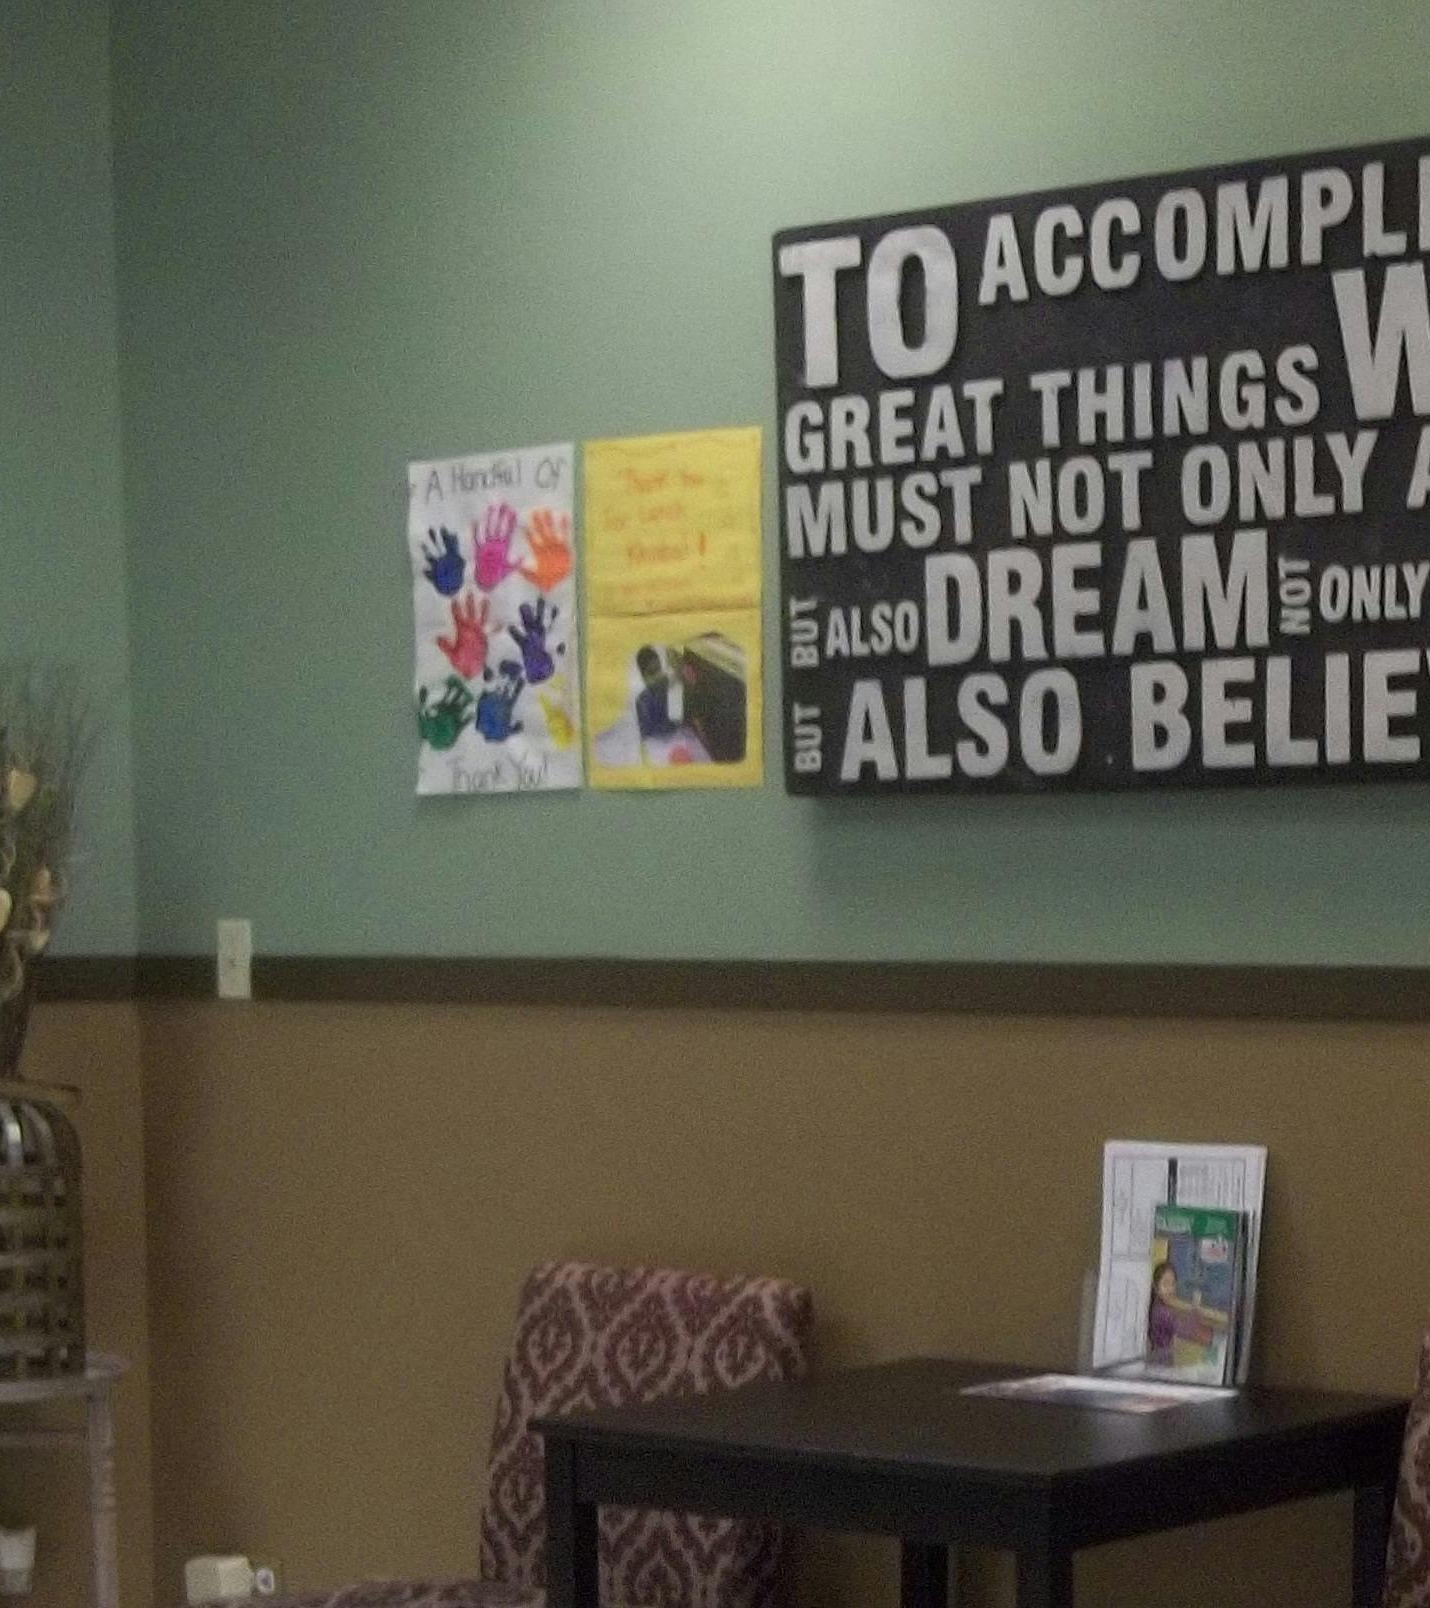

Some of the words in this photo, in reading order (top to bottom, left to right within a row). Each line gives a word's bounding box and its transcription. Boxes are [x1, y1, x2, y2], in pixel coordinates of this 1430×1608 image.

[778, 224, 959, 389] TO
[785, 377, 1007, 475] GREAT
[1030, 344, 1321, 449] THINGS
[424, 469, 444, 506] A
[785, 467, 982, 559] MUST
[1009, 451, 1155, 539] NOT
[1181, 428, 1376, 526] ONLY
[790, 595, 821, 669] BUT
[825, 599, 921, 658] ALSO
[925, 530, 1271, 669] DREAM
[1278, 556, 1313, 636] NOT
[1318, 562, 1430, 624] ONLY
[793, 701, 824, 775] BUT
[839, 667, 1084, 783] ALSO
